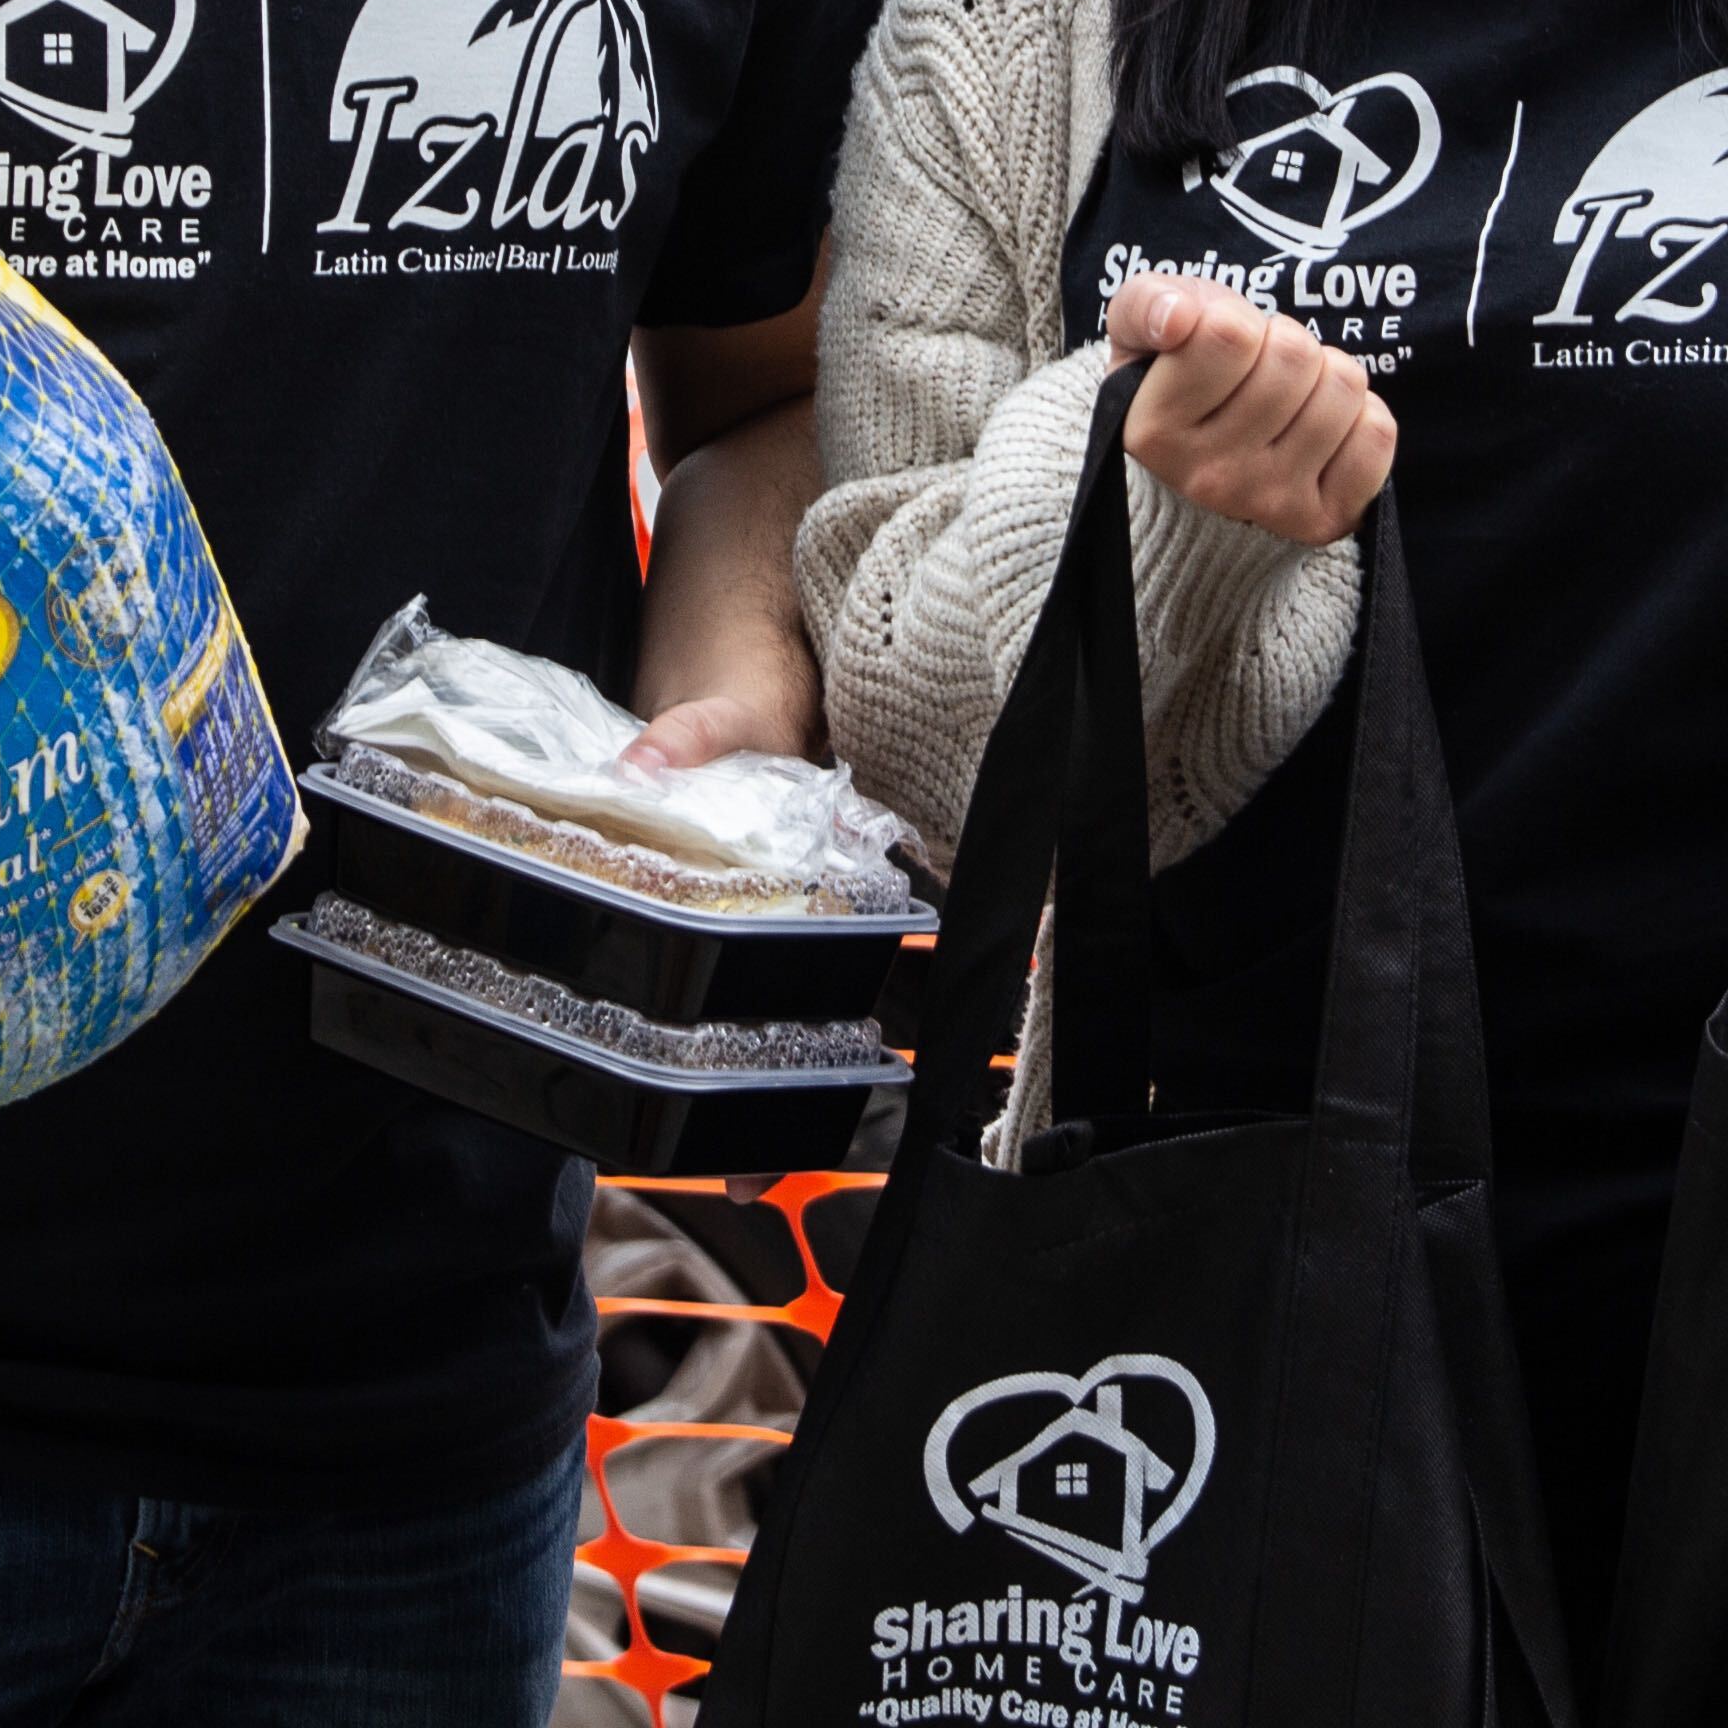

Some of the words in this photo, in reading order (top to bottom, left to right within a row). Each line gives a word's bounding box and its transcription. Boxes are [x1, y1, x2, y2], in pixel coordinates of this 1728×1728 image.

[94, 152, 212, 208] Love
[63, 213, 200, 244] CARE
[66, 250, 98, 278] at
[106, 250, 211, 279] Home”
[313, 248, 387, 275] Latin
[1294, 259, 1416, 308] Love
[1305, 316, 1401, 341] ARE
[1532, 341, 1613, 368] Latin
[871, 1584, 1096, 1665] Sharing
[1104, 1594, 1200, 1674] Love
[882, 1652, 1041, 1691] HOME
[1075, 1658, 1184, 1715] CARE
[1001, 1689, 1068, 1728] Care
